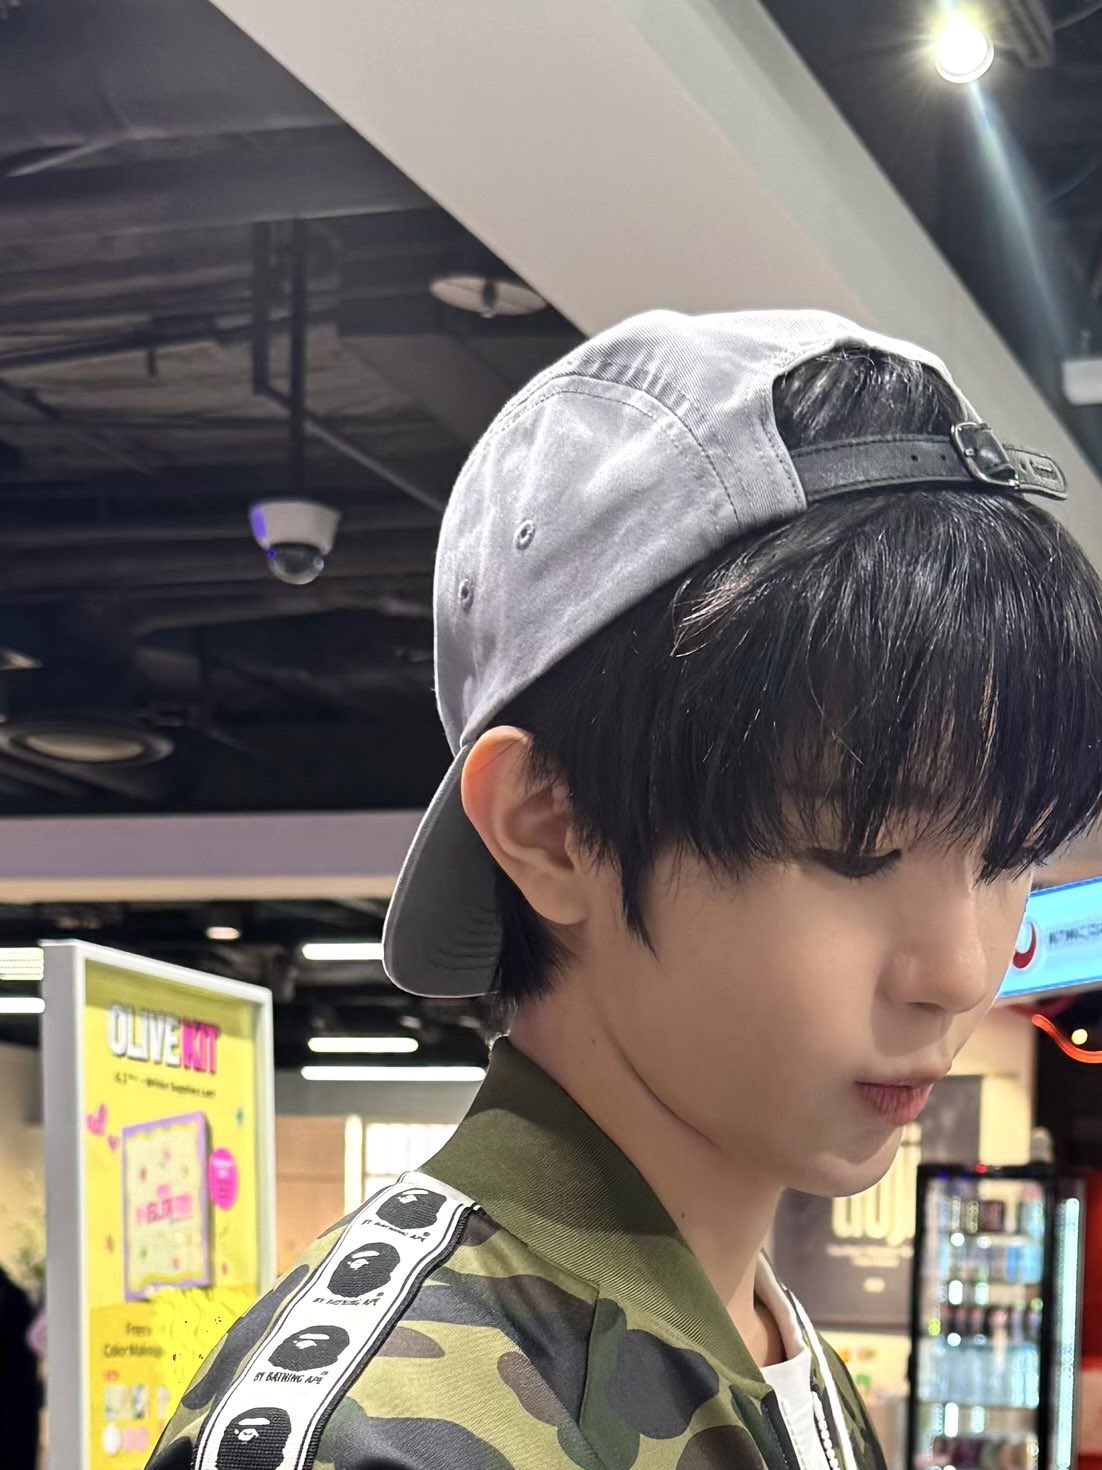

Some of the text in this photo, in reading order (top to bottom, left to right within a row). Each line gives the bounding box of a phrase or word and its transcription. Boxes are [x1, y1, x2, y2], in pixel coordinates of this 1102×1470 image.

[253, 1371, 323, 1385] BY BATHING APE
